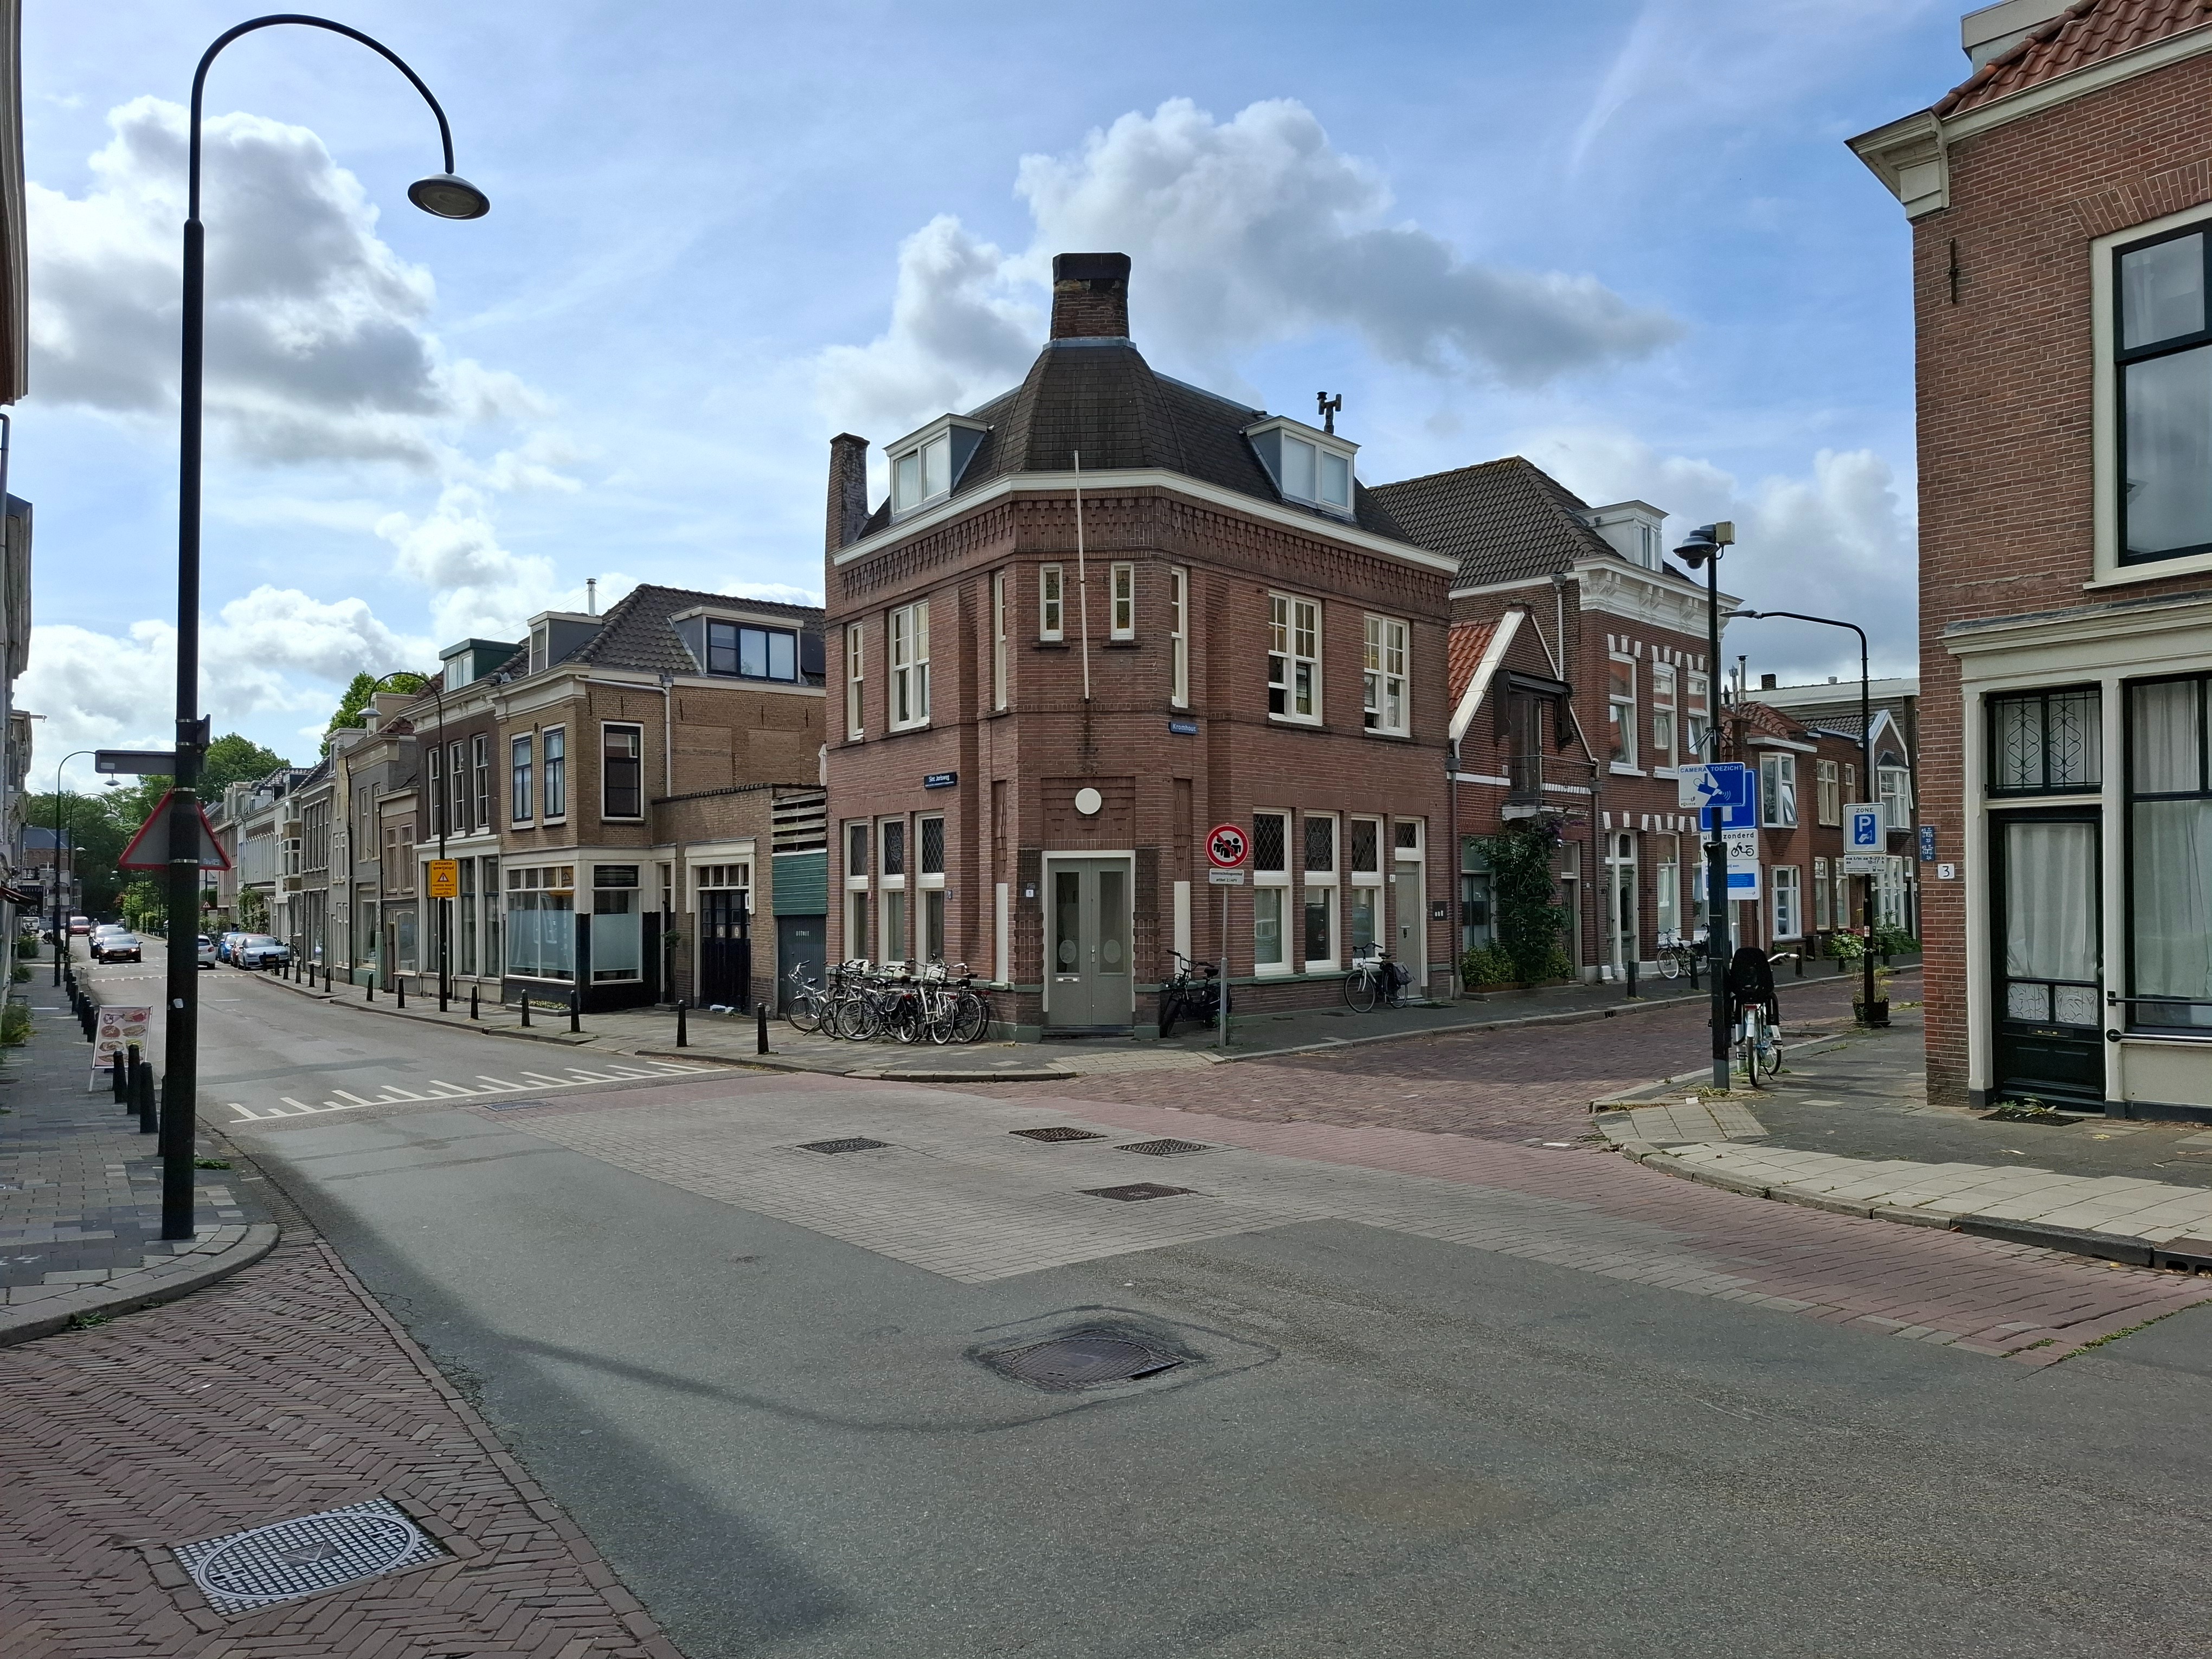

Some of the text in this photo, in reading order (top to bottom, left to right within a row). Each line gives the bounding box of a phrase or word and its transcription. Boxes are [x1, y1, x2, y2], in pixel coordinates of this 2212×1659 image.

[1173, 723, 1196, 732] Kromhout
[1859, 816, 1872, 832] P
[1942, 865, 1950, 877] 3
